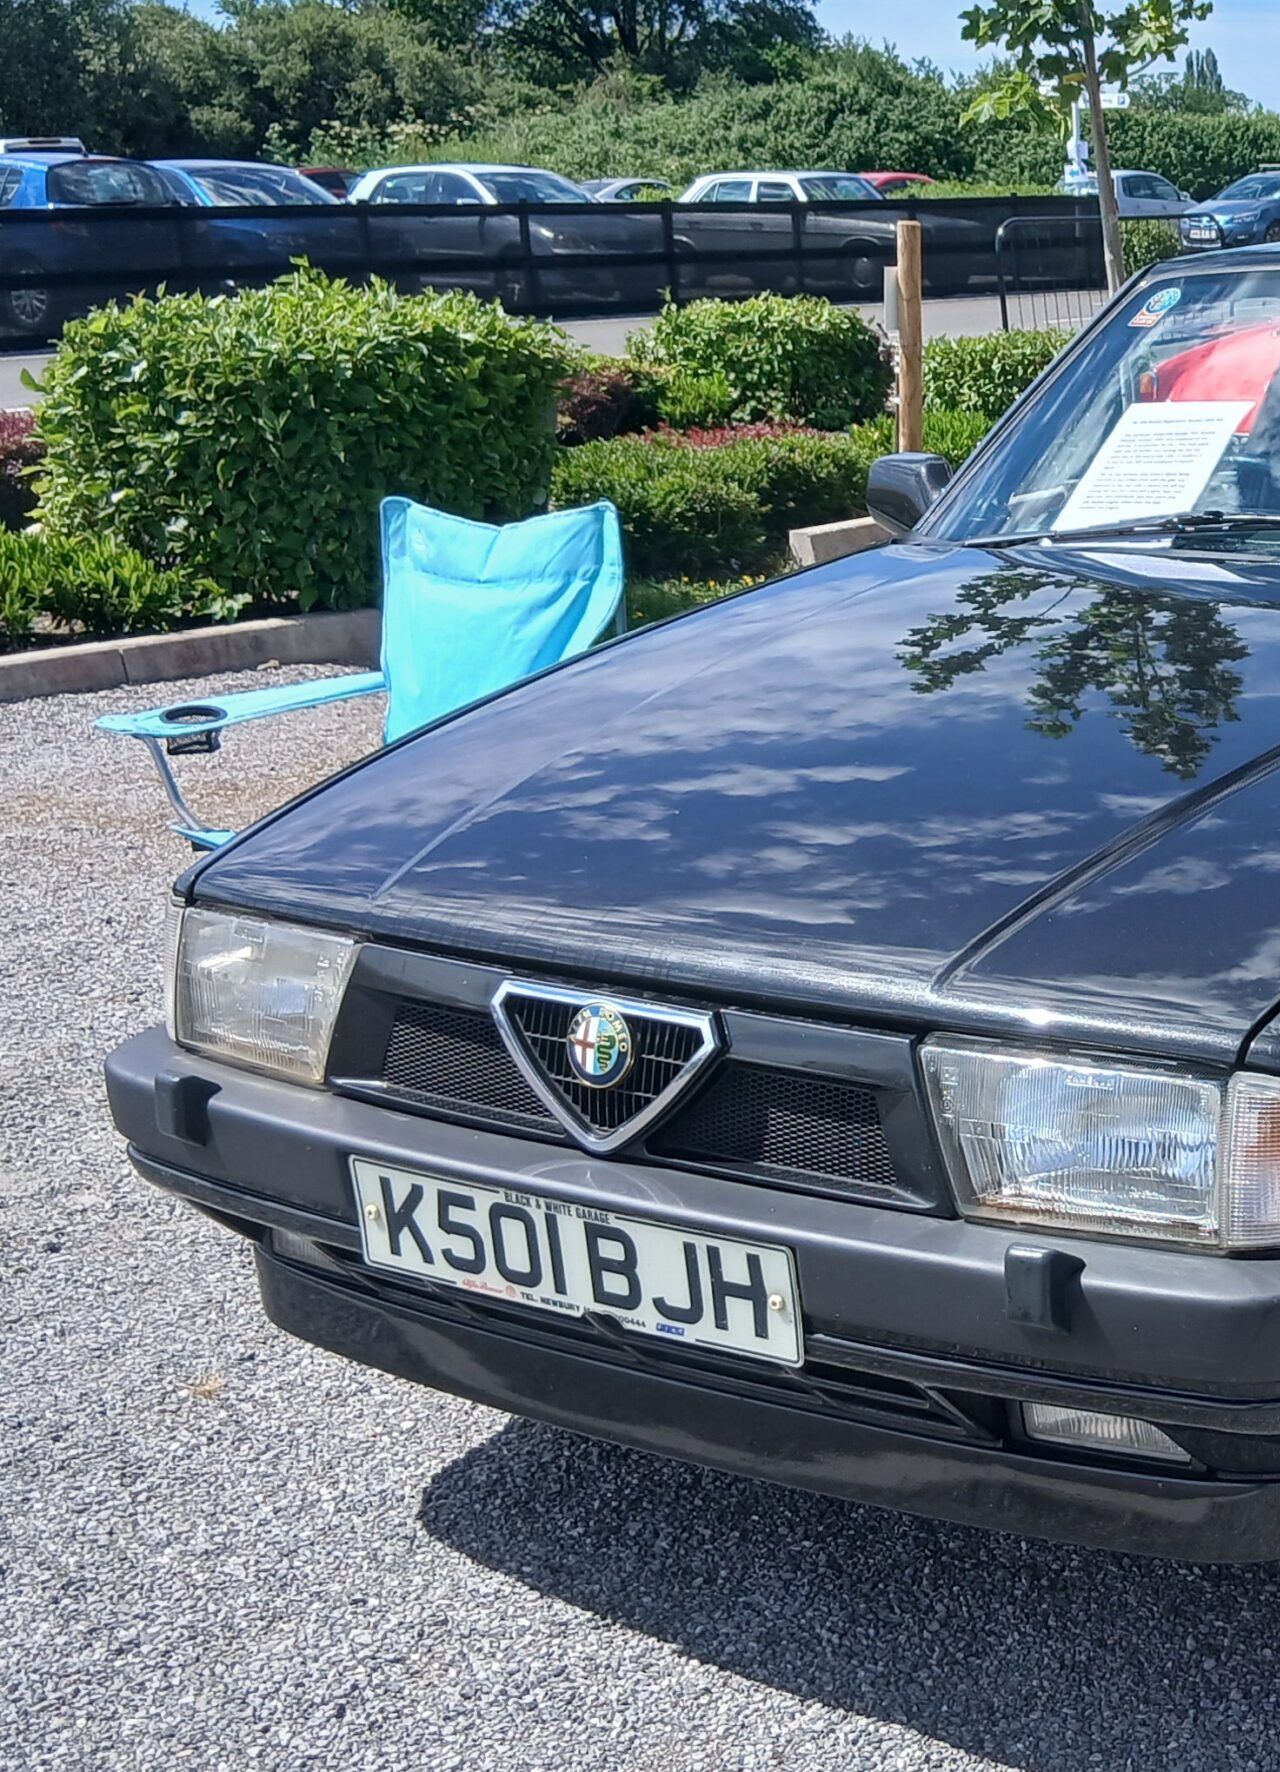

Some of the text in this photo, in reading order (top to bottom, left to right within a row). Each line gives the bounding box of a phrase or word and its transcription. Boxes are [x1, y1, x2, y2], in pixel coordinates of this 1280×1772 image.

[600, 1006, 628, 1052] ROMEO
[503, 1191, 612, 1225] BLACK & WHITE GARAGE
[378, 1175, 770, 1340] K501 BJH
[520, 1291, 538, 1302] TEL.
[540, 1295, 580, 1312] NEWBURY
